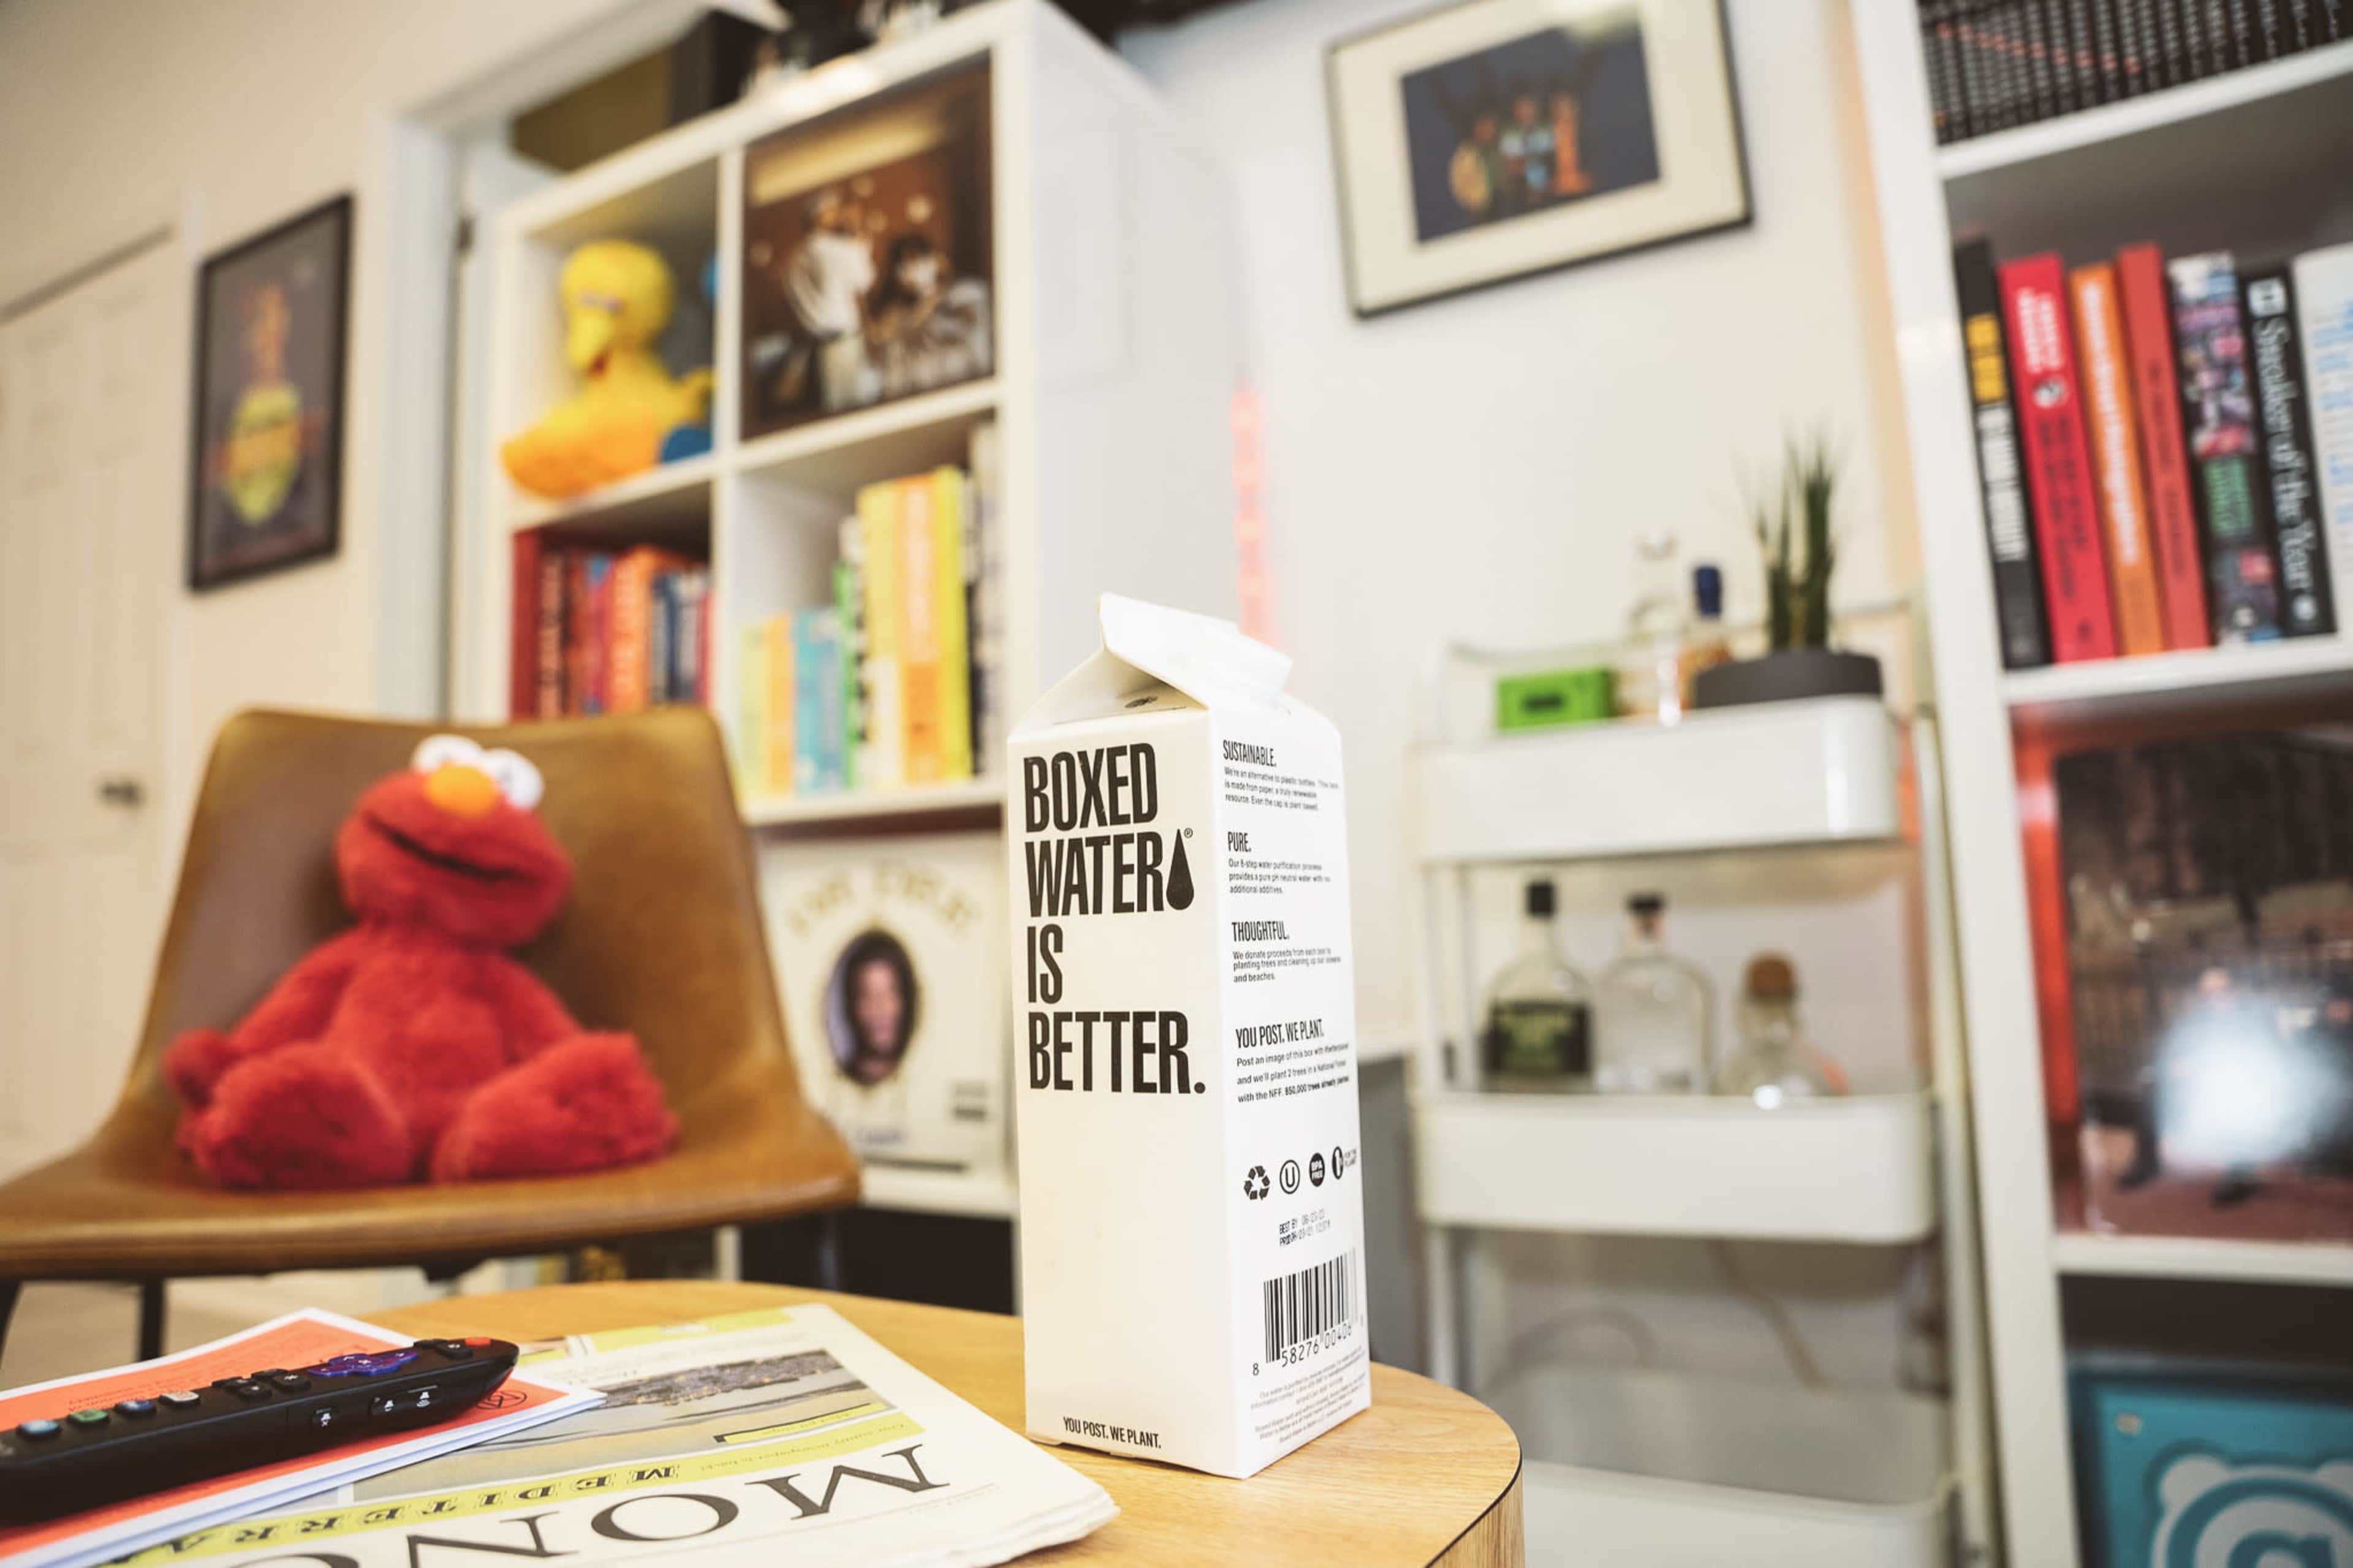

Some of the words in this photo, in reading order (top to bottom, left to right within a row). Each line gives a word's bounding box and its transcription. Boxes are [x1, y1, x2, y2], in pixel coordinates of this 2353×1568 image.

[1223, 740, 1276, 767] SUSTAINABLE.
[1023, 742, 1158, 833] BOXED
[1227, 831, 1251, 852] PURE.
[1025, 831, 1164, 918] WATER
[1232, 921, 1290, 942] THOUGHTFUL.
[1027, 923, 1063, 1004] IS
[1233, 974, 1248, 983] and
[1235, 1026, 1257, 1048] YOU
[1259, 1024, 1285, 1046] POST.
[1285, 1021, 1299, 1042] WE
[1300, 1018, 1324, 1040] PLANT.
[1029, 1011, 1207, 1094] BETTER.
[1237, 1056, 1254, 1067] Post
[1265, 1053, 1285, 1064] image
[1237, 1075, 1252, 1085] and
[1270, 1070, 1287, 1081] plant
[1238, 1092, 1254, 1102] with
[1256, 1089, 1268, 1100] the
[1252, 1362, 1259, 1376] 8
[1282, 1339, 1319, 1368] 58276
[1063, 1416, 1081, 1434] YOU
[1083, 1420, 1108, 1439] POST.
[1110, 1425, 1126, 1442] WE
[1127, 1429, 1162, 1449] PLANT.
